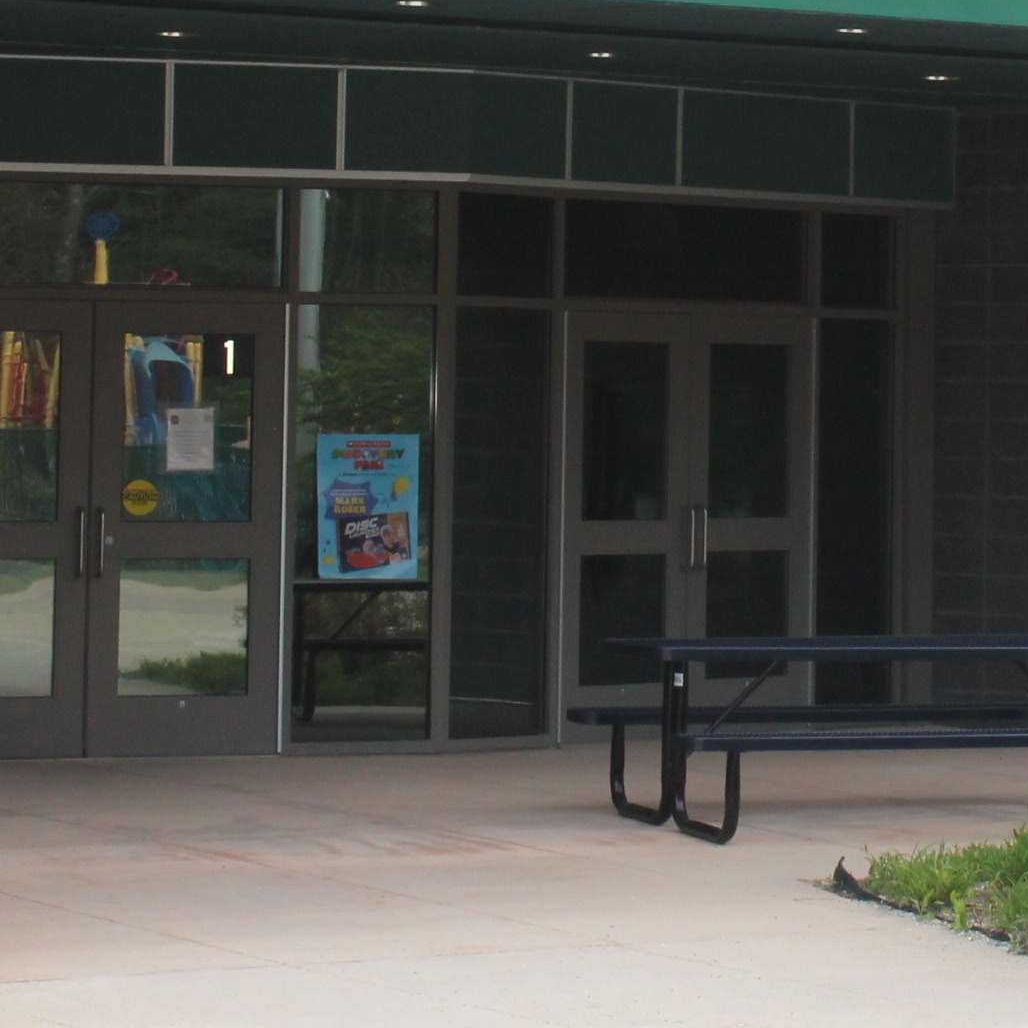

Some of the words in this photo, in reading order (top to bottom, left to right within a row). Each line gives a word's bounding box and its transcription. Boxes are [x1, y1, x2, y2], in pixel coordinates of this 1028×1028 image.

[223, 339, 235, 375] 1
[335, 497, 365, 505] MARK
[334, 505, 366, 514] ROBER
[344, 517, 378, 536] DISC
